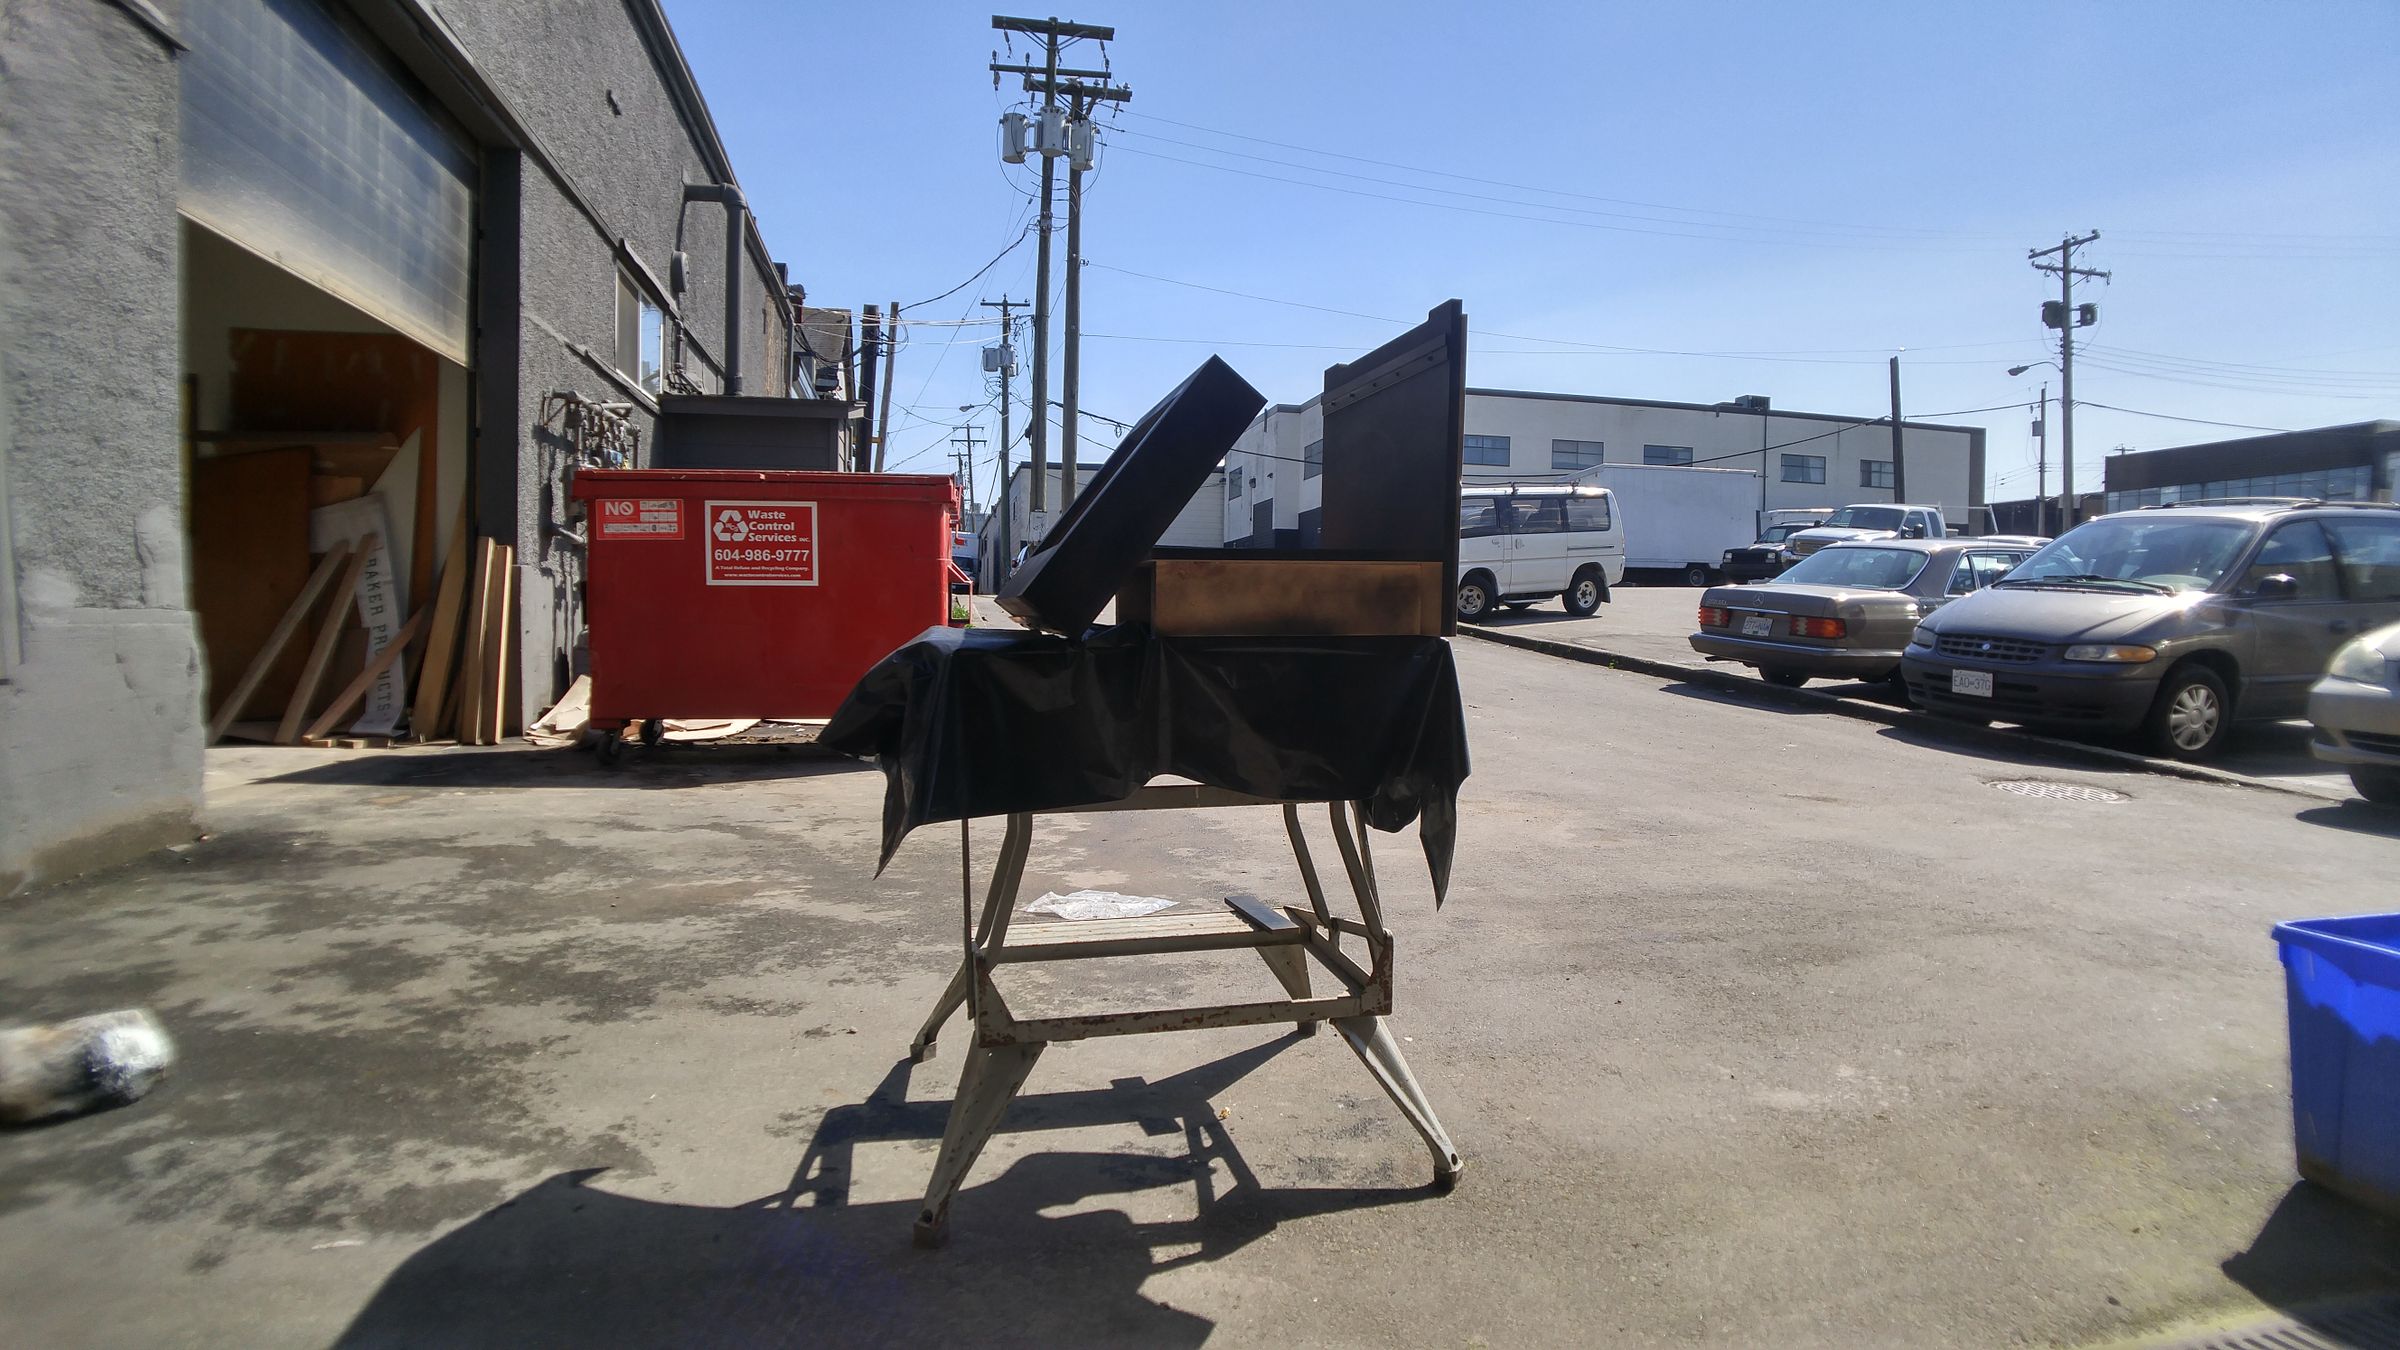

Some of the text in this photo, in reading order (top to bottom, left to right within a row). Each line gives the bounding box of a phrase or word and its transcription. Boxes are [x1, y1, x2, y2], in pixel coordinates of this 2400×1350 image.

[604, 501, 634, 516] NO
[747, 510, 786, 519] Waste
[748, 521, 795, 531] Control
[748, 533, 797, 542] Services
[714, 549, 810, 561] 604-986-9777
